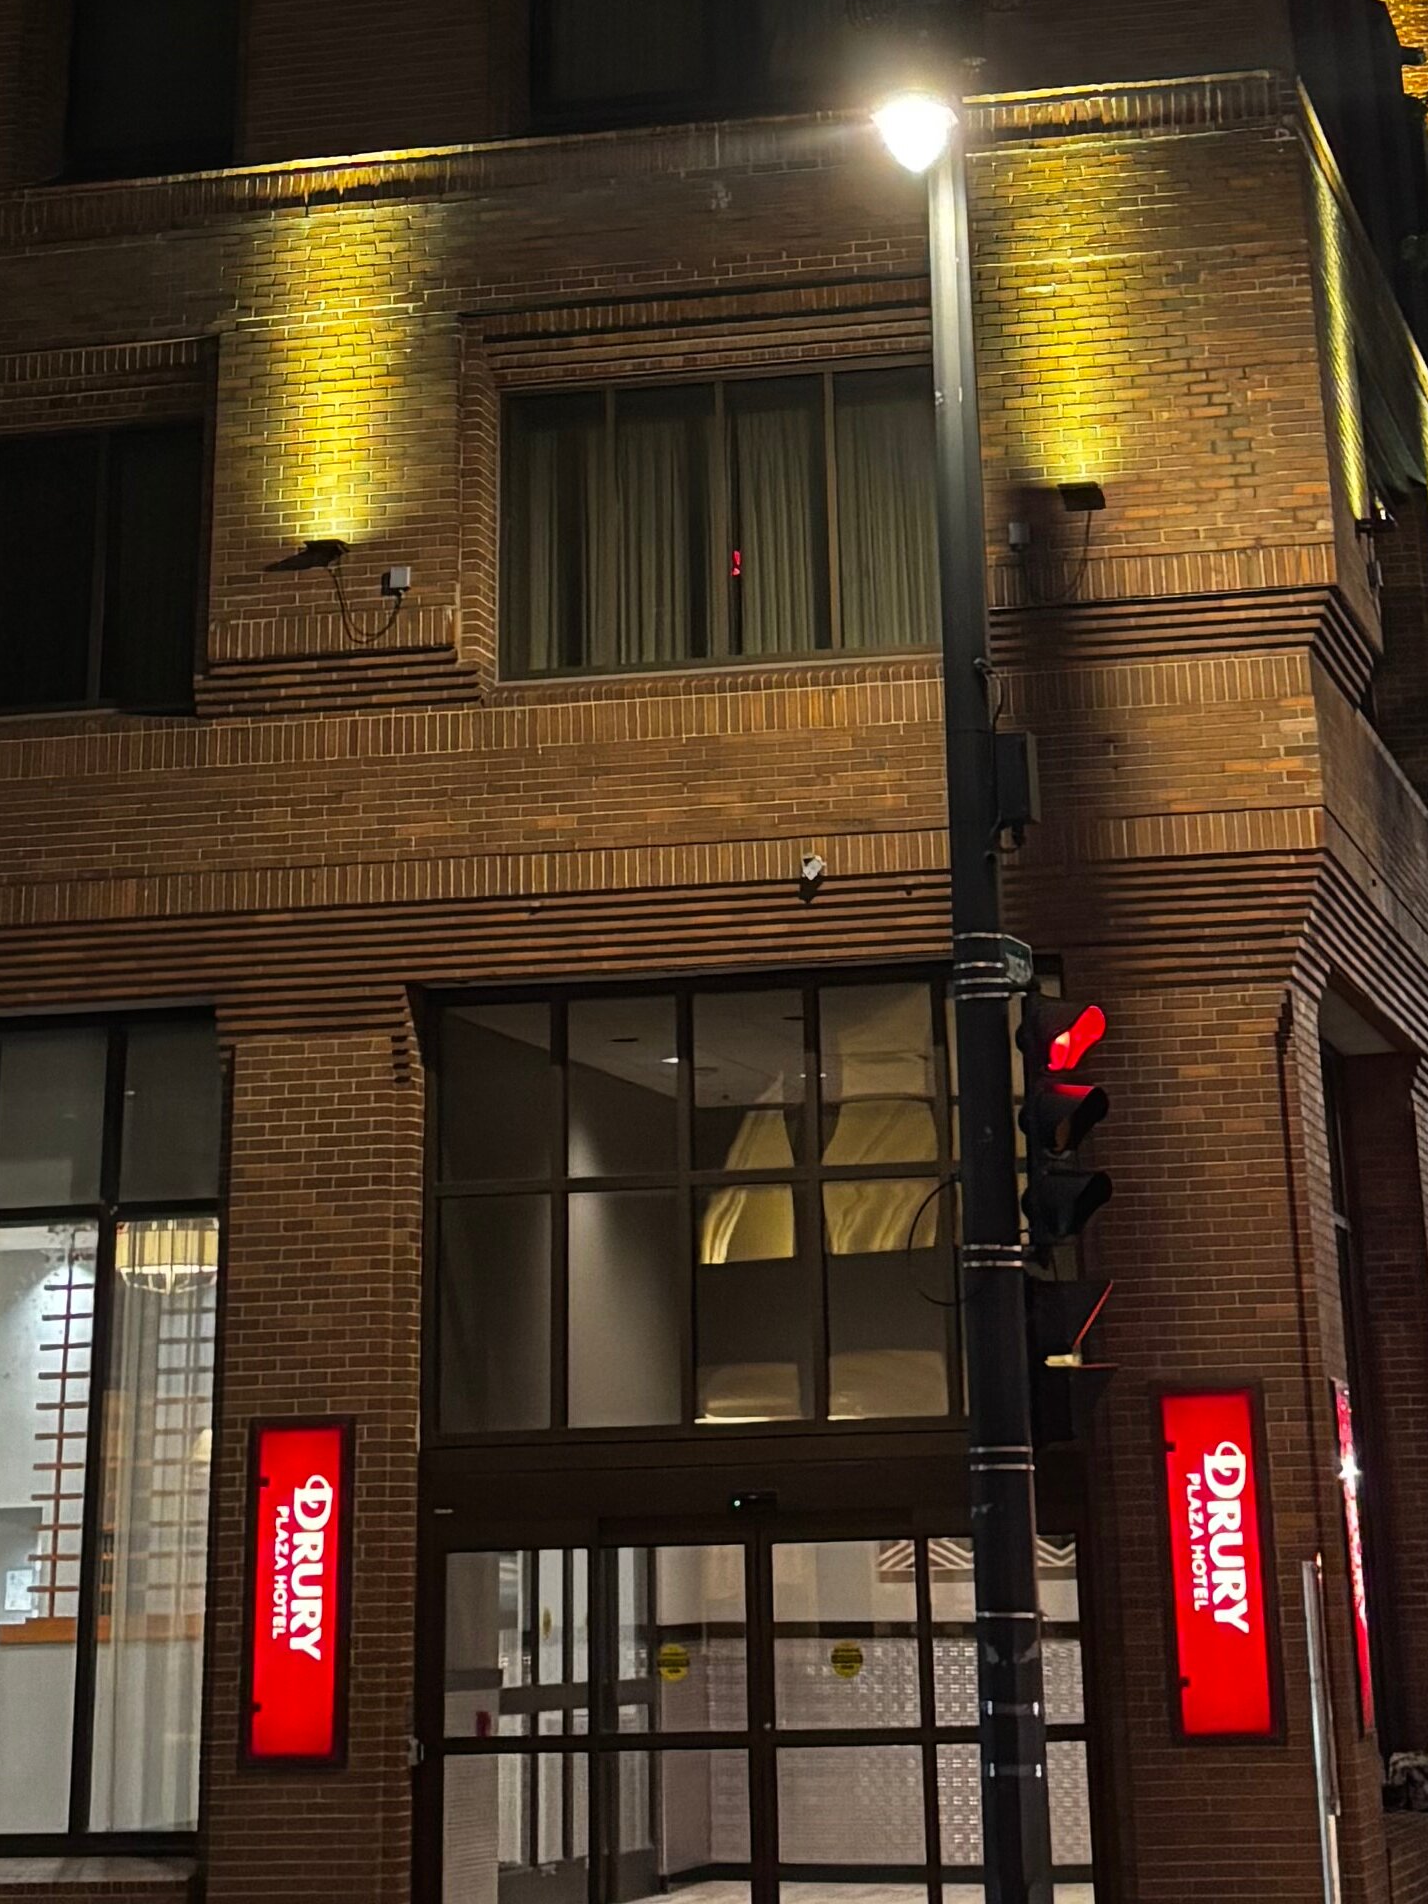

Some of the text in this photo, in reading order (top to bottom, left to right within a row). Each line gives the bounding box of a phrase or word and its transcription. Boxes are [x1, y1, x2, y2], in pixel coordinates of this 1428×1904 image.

[272, 1506, 289, 1639] PLAZA HOTEL
[289, 1473, 334, 1661] DRURY
[1186, 1473, 1209, 1611] PLAZA HOTEL
[1203, 1440, 1250, 1634] DRURY
